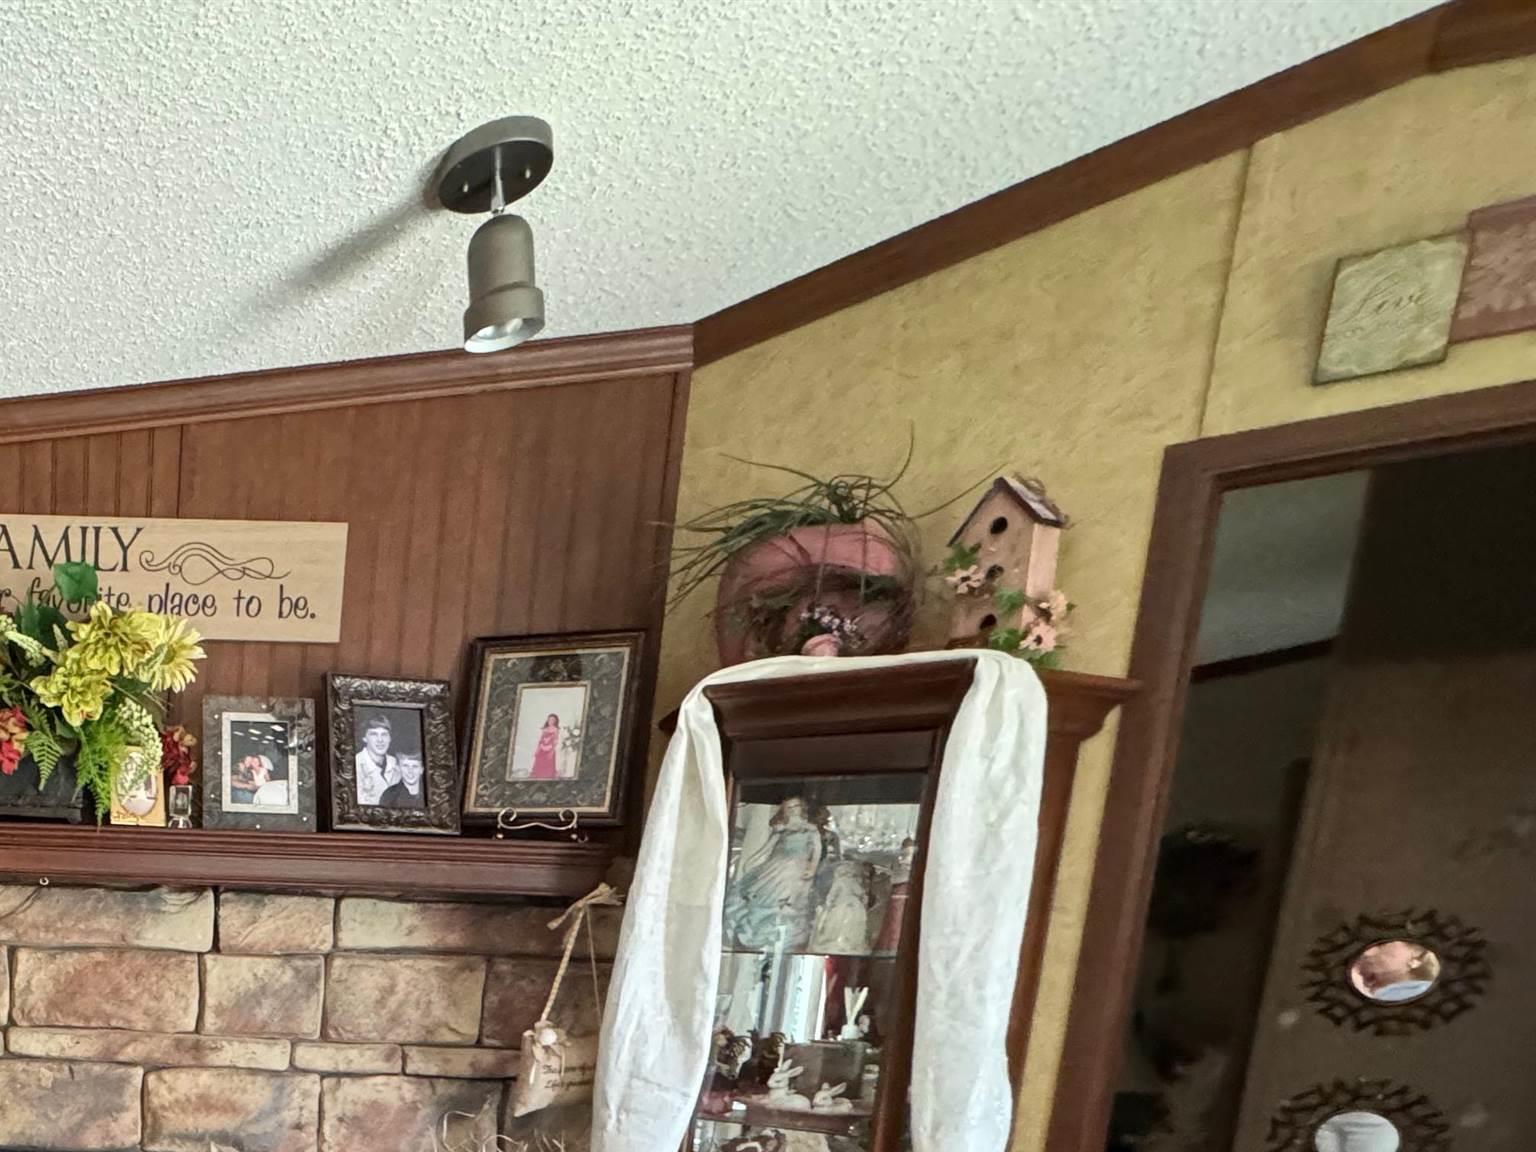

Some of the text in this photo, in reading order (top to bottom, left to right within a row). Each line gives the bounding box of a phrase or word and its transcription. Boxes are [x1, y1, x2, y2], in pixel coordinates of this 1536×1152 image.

[148, 582, 219, 617] place
[233, 588, 262, 618] to
[278, 584, 317, 619] be.
